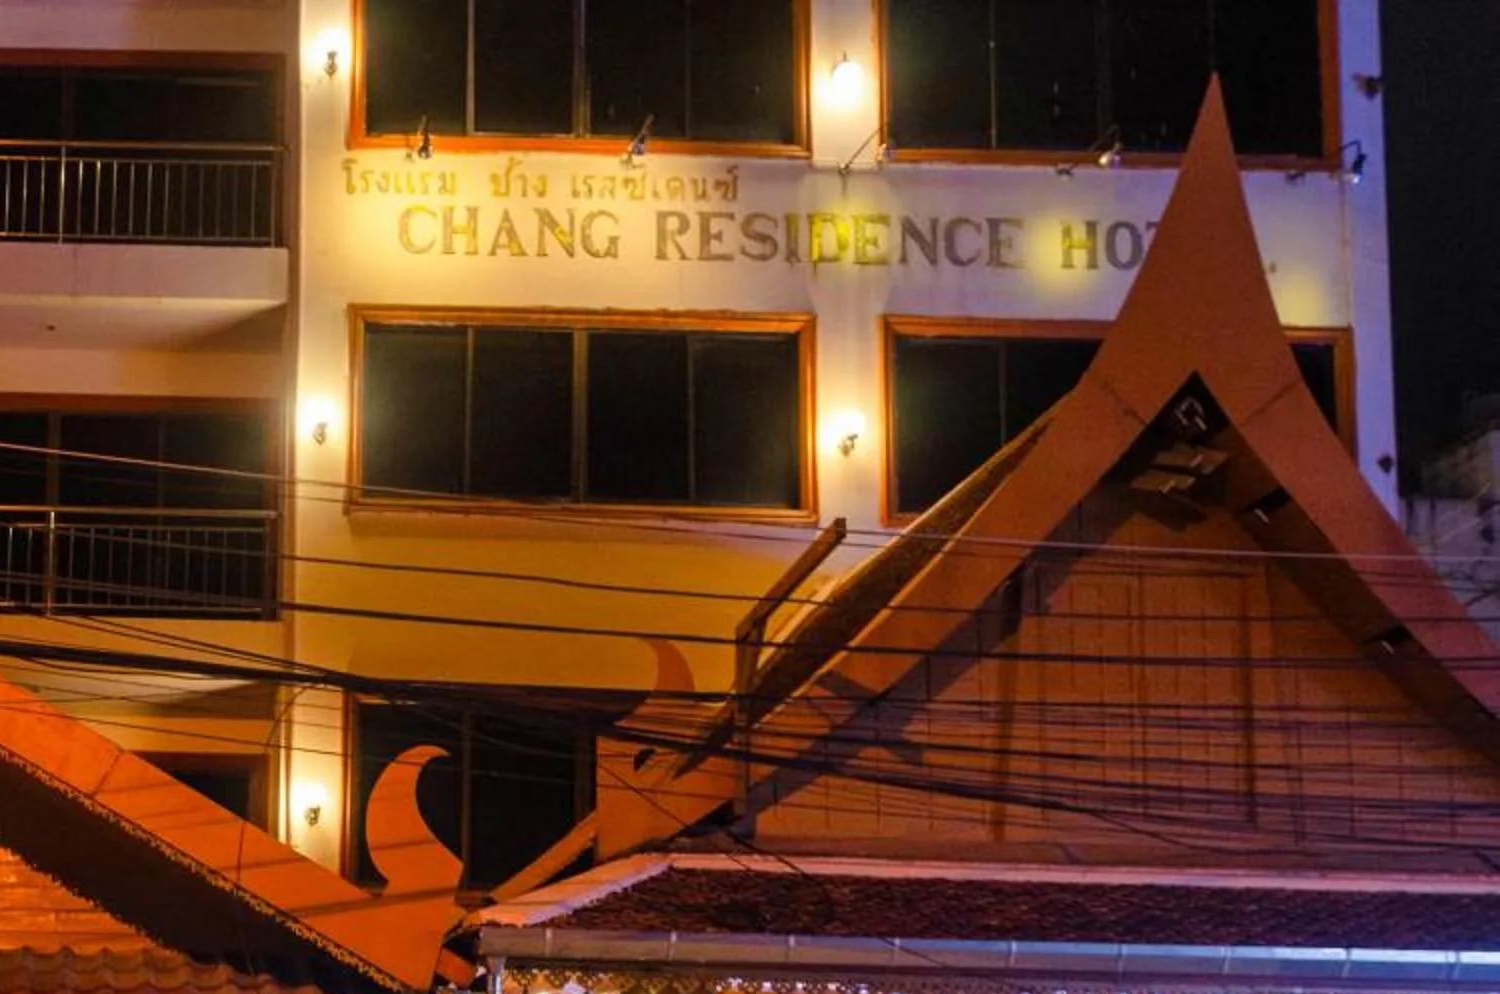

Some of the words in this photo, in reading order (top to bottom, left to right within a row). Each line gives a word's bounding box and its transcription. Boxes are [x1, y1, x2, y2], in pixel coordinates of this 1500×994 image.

[342, 158, 457, 195] โรงแรม
[399, 205, 621, 259] CHANG
[654, 209, 1024, 269] RESIDENCE
